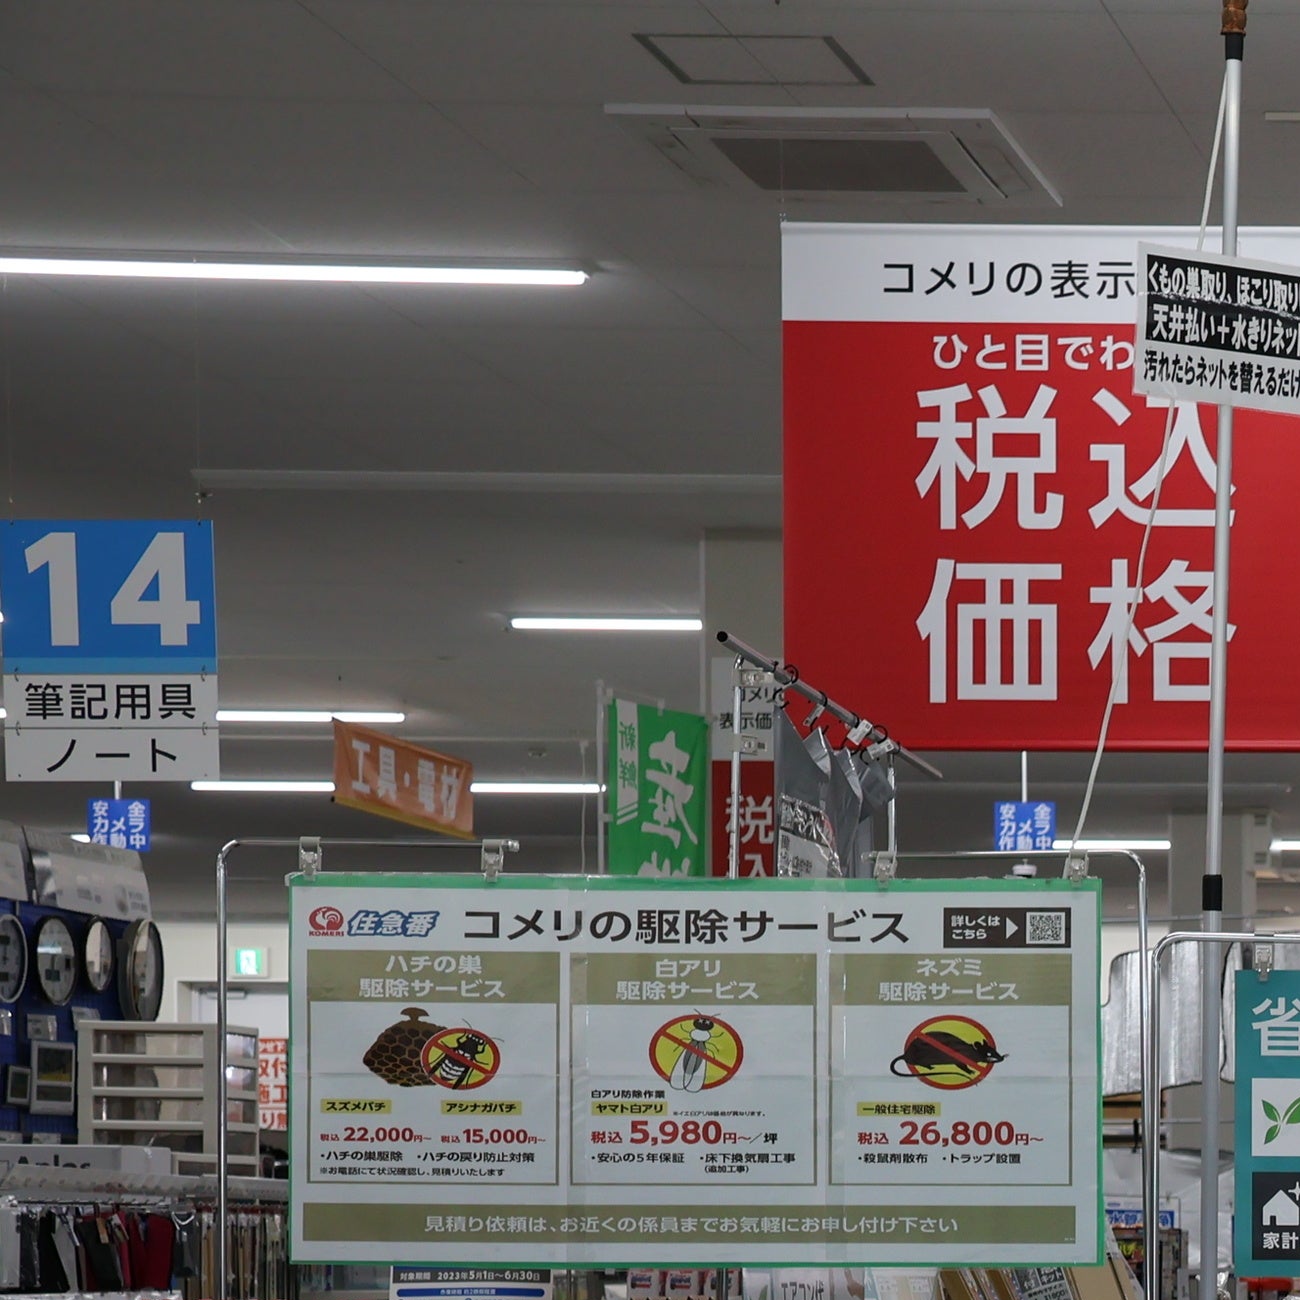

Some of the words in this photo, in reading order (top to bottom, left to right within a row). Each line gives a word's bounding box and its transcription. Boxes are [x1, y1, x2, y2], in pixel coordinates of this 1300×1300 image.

[915, 386, 1236, 530] 税込
[25, 532, 200, 646] 14
[915, 558, 1237, 704] 価格
[25, 683, 196, 719] 筆記用具
[47, 739, 176, 772] ノート
[347, 910, 440, 937] 住急番
[464, 908, 909, 945] コメリの駆除サービス
[951, 928, 987, 939] こちら
[385, 955, 482, 974] ハチの巣
[655, 959, 721, 978] 白アリ
[917, 958, 983, 977] ネズミ
[359, 978, 506, 999] 駆除サービス
[616, 980, 760, 1001] 駆除サービス
[879, 981, 1019, 1002] 駆除サービス
[445, 1102, 517, 1113] アシナガバチ
[596, 1102, 664, 1113] ヤマト白アリ
